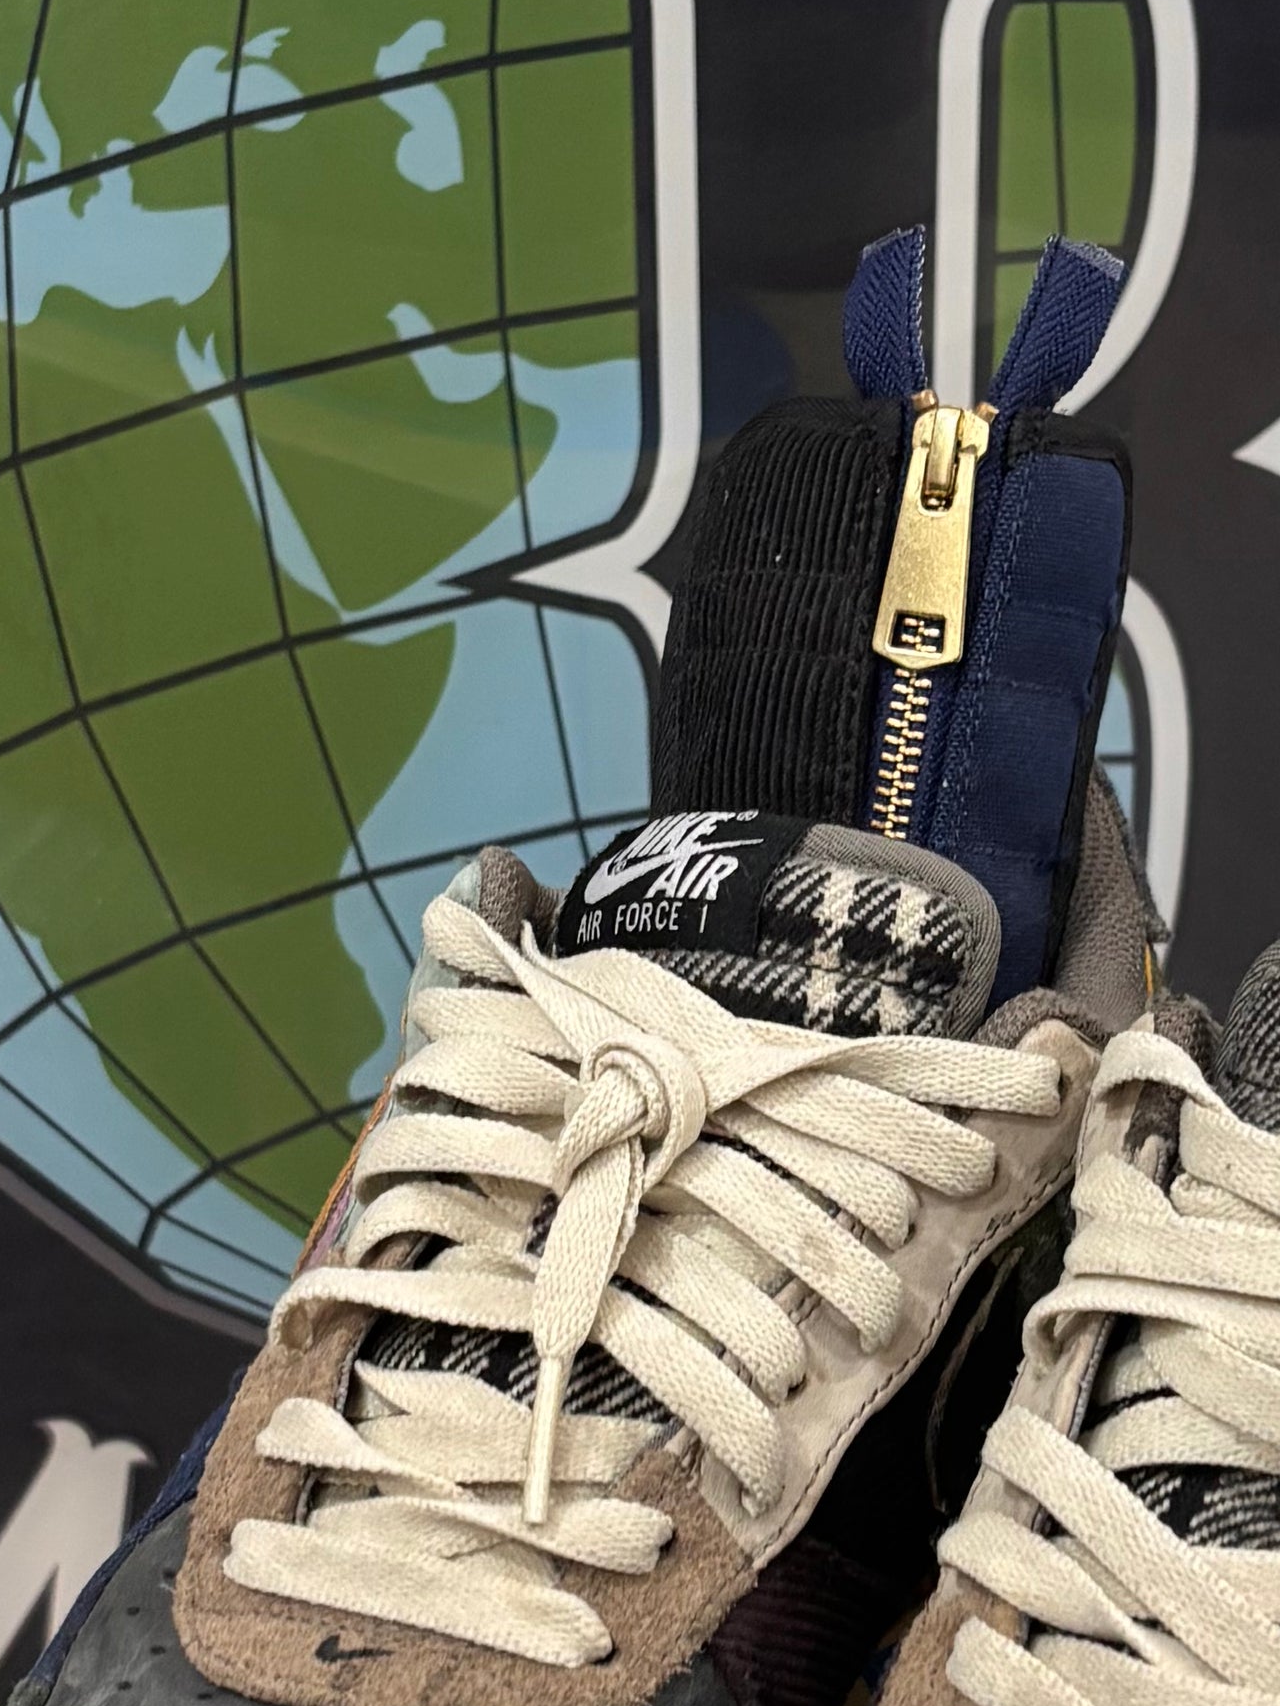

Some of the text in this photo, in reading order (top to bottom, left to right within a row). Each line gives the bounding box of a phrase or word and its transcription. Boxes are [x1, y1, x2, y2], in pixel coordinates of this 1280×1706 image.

[613, 811, 736, 860] NIKE
[642, 852, 739, 901] AIR
[576, 900, 709, 944] AIR FORCE 1
